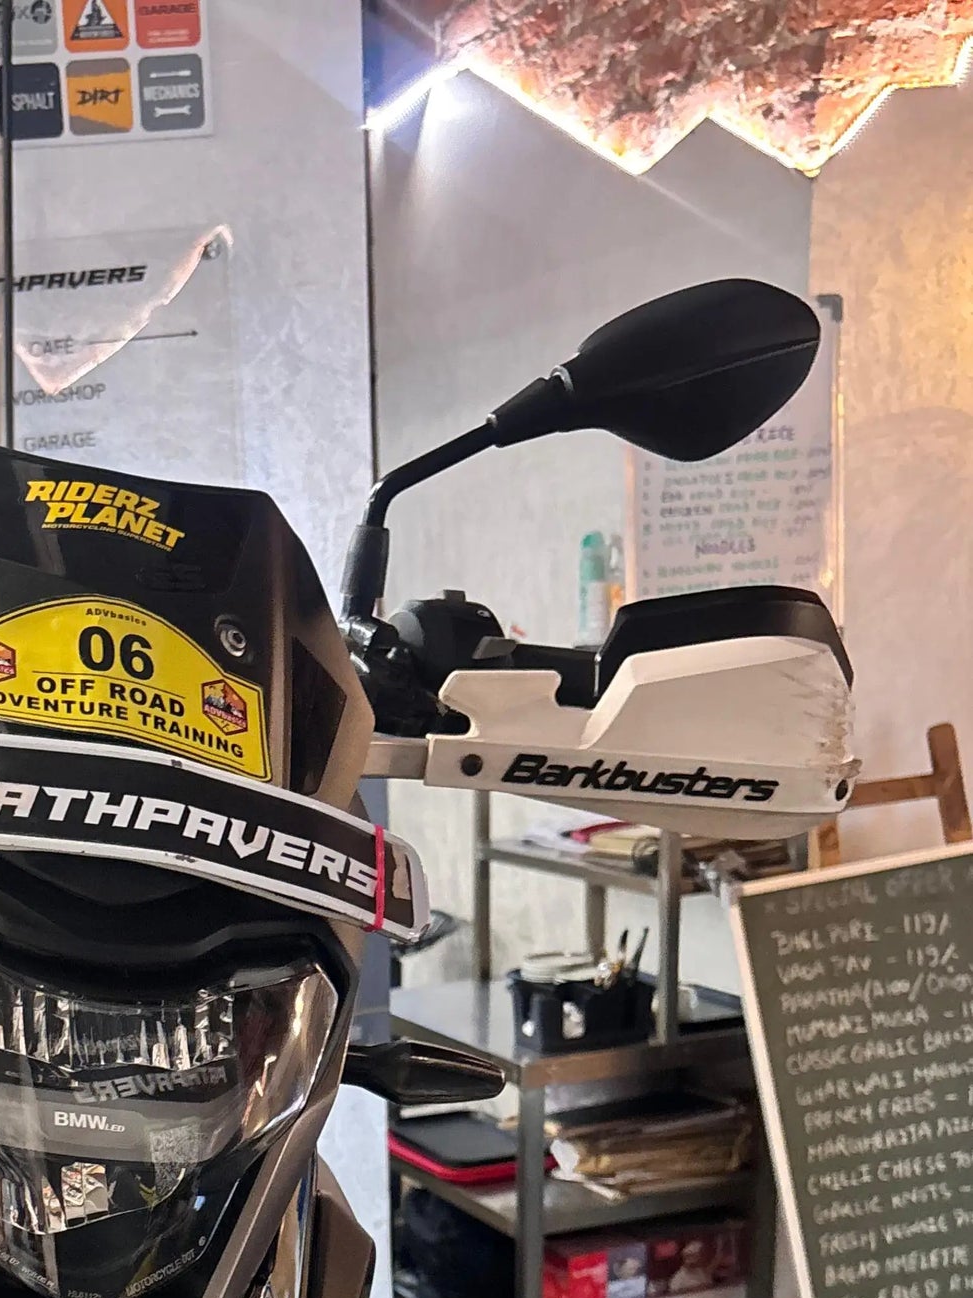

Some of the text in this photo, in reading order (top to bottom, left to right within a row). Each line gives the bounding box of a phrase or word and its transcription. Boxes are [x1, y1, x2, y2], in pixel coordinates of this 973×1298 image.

[11, 92, 55, 112] SPHALT
[77, 88, 125, 106] DIRT
[144, 83, 200, 101] MECHANICS
[23, 431, 97, 451] GARAGE
[25, 481, 160, 518] RIDERZ
[41, 522, 116, 534] MOTORCYCLING
[44, 502, 185, 548] PLANET
[85, 607, 148, 627] ADVbasics
[78, 626, 155, 681] 06
[36, 677, 185, 717] OFF ROAD
[138, 710, 244, 759] TRAINING
[501, 753, 779, 801] Barkbusters
[54, 1110, 126, 1133] BMW LED
[124, 1259, 181, 1298] MOTORCYCLE
